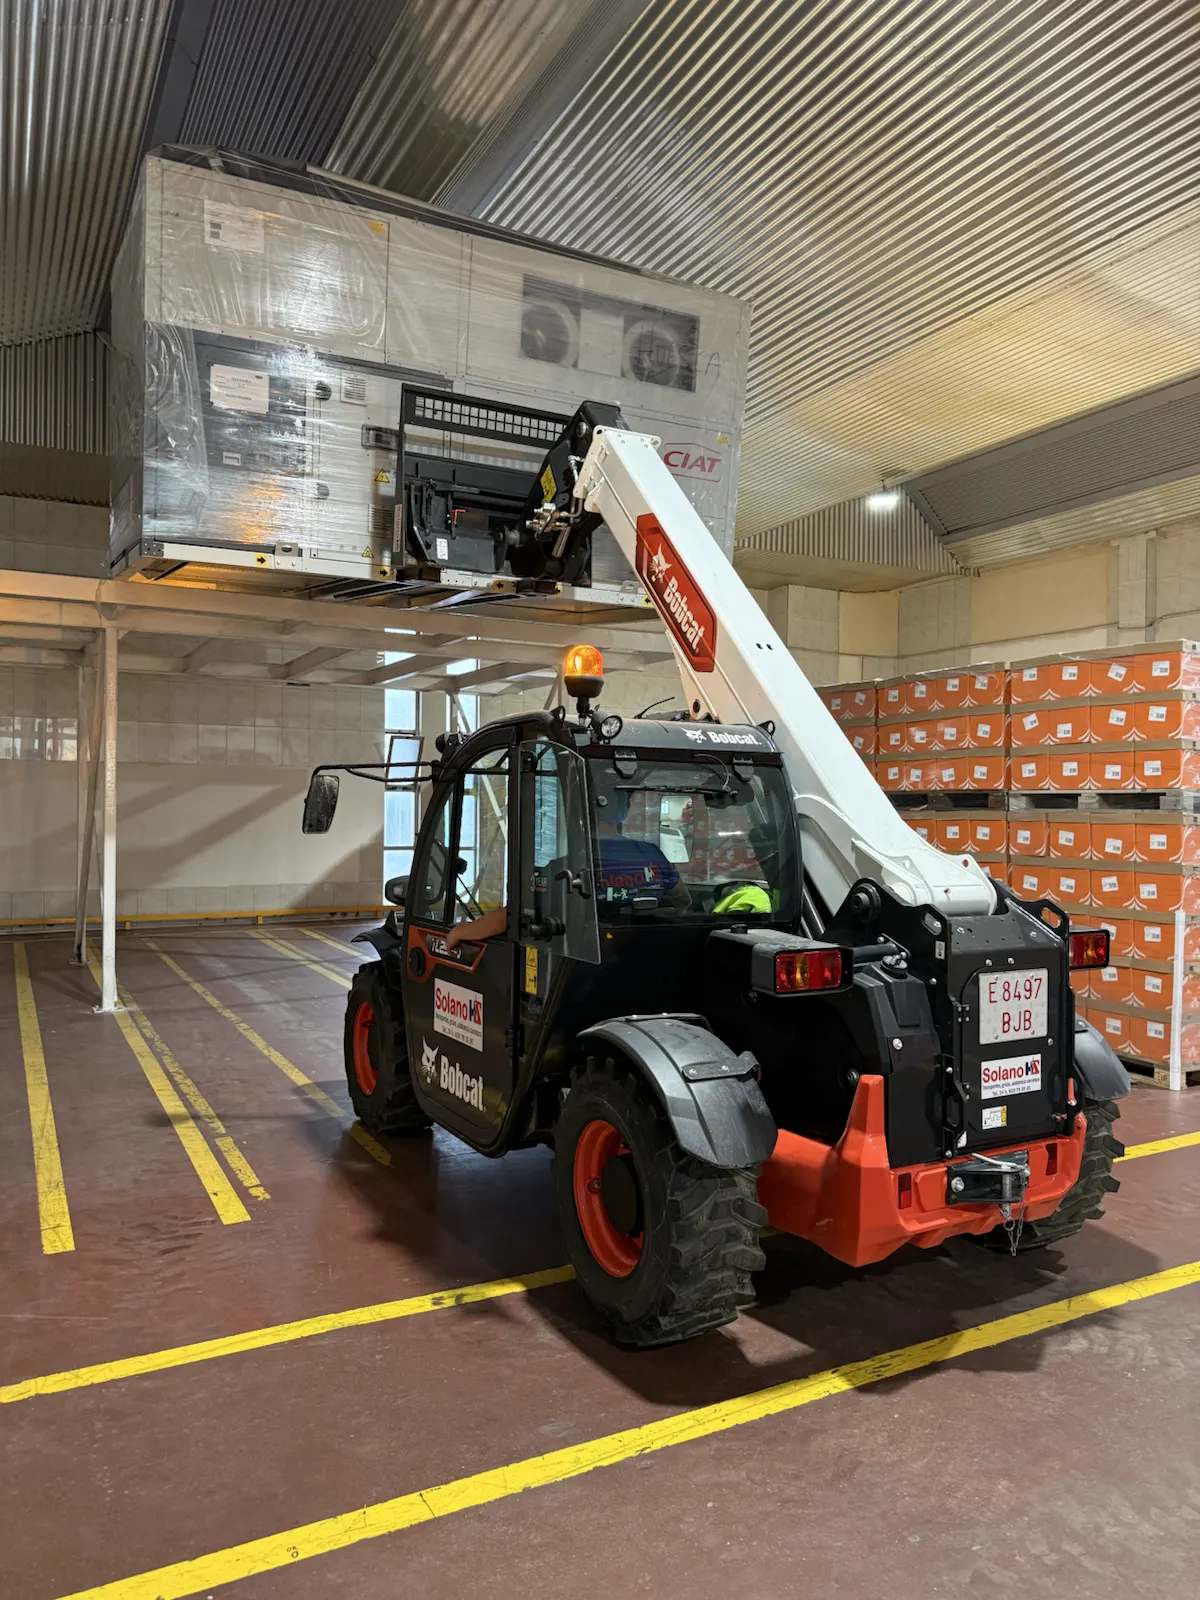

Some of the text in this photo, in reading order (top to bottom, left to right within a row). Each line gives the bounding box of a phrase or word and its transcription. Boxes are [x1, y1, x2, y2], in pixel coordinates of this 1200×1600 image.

[663, 450, 722, 473] CIAT
[663, 576, 705, 652] Bobcat
[707, 731, 761, 745] Bobcat
[988, 977, 1043, 1004] E 8497
[435, 987, 468, 1021] Solano
[1002, 1009, 1032, 1034] BJB
[440, 1054, 484, 1112] Bobcat
[982, 1065, 1024, 1084] Solano
